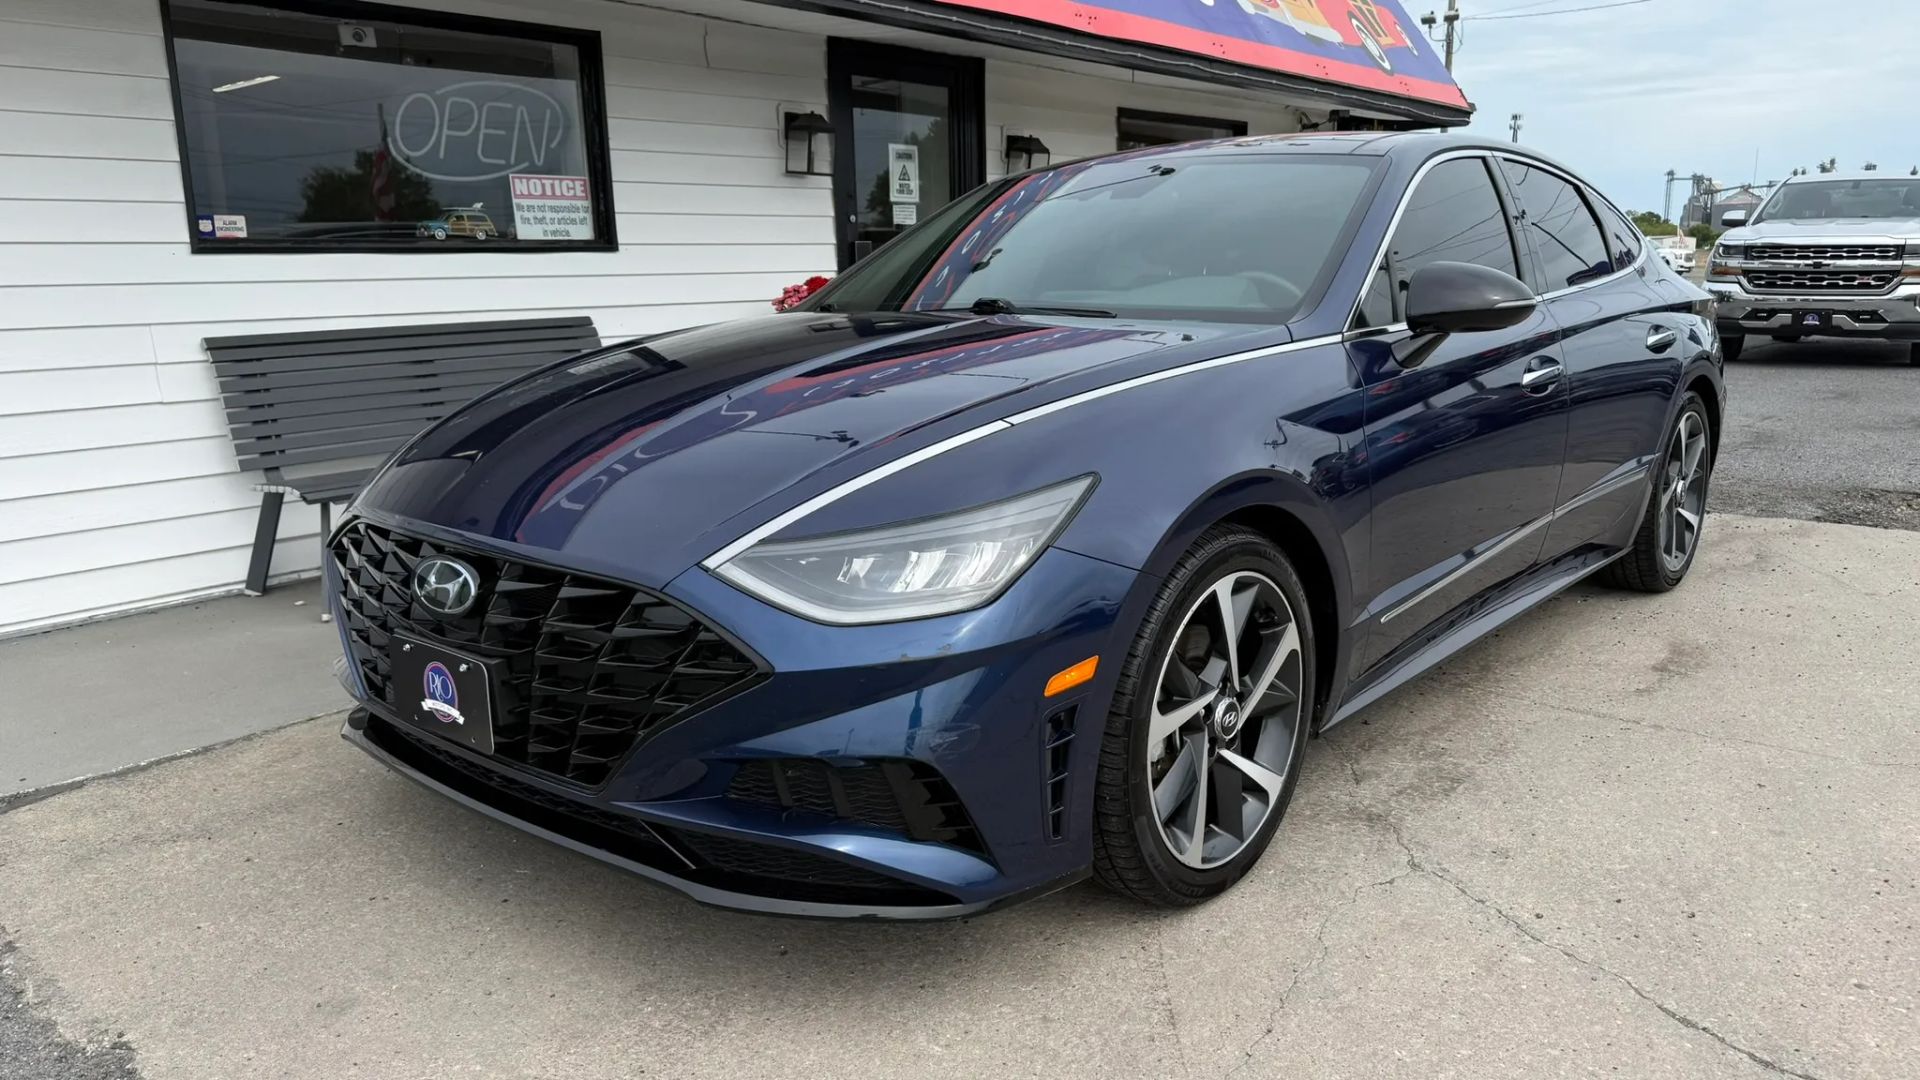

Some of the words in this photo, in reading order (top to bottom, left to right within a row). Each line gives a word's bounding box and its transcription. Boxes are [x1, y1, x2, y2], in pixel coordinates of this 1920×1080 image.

[395, 92, 550, 166] OPEN
[513, 178, 586, 197] NOTICE
[514, 202, 525, 213] We
[526, 204, 536, 213] are
[536, 203, 547, 213] not
[547, 202, 580, 215] responsible
[581, 203, 590, 213] for
[520, 215, 532, 226] fire,
[533, 215, 549, 226] theft,
[549, 217, 556, 225] or
[557, 215, 578, 226] articles
[578, 215, 588, 226] left
[543, 228, 549, 237] in
[549, 228, 571, 237] vehicle.
